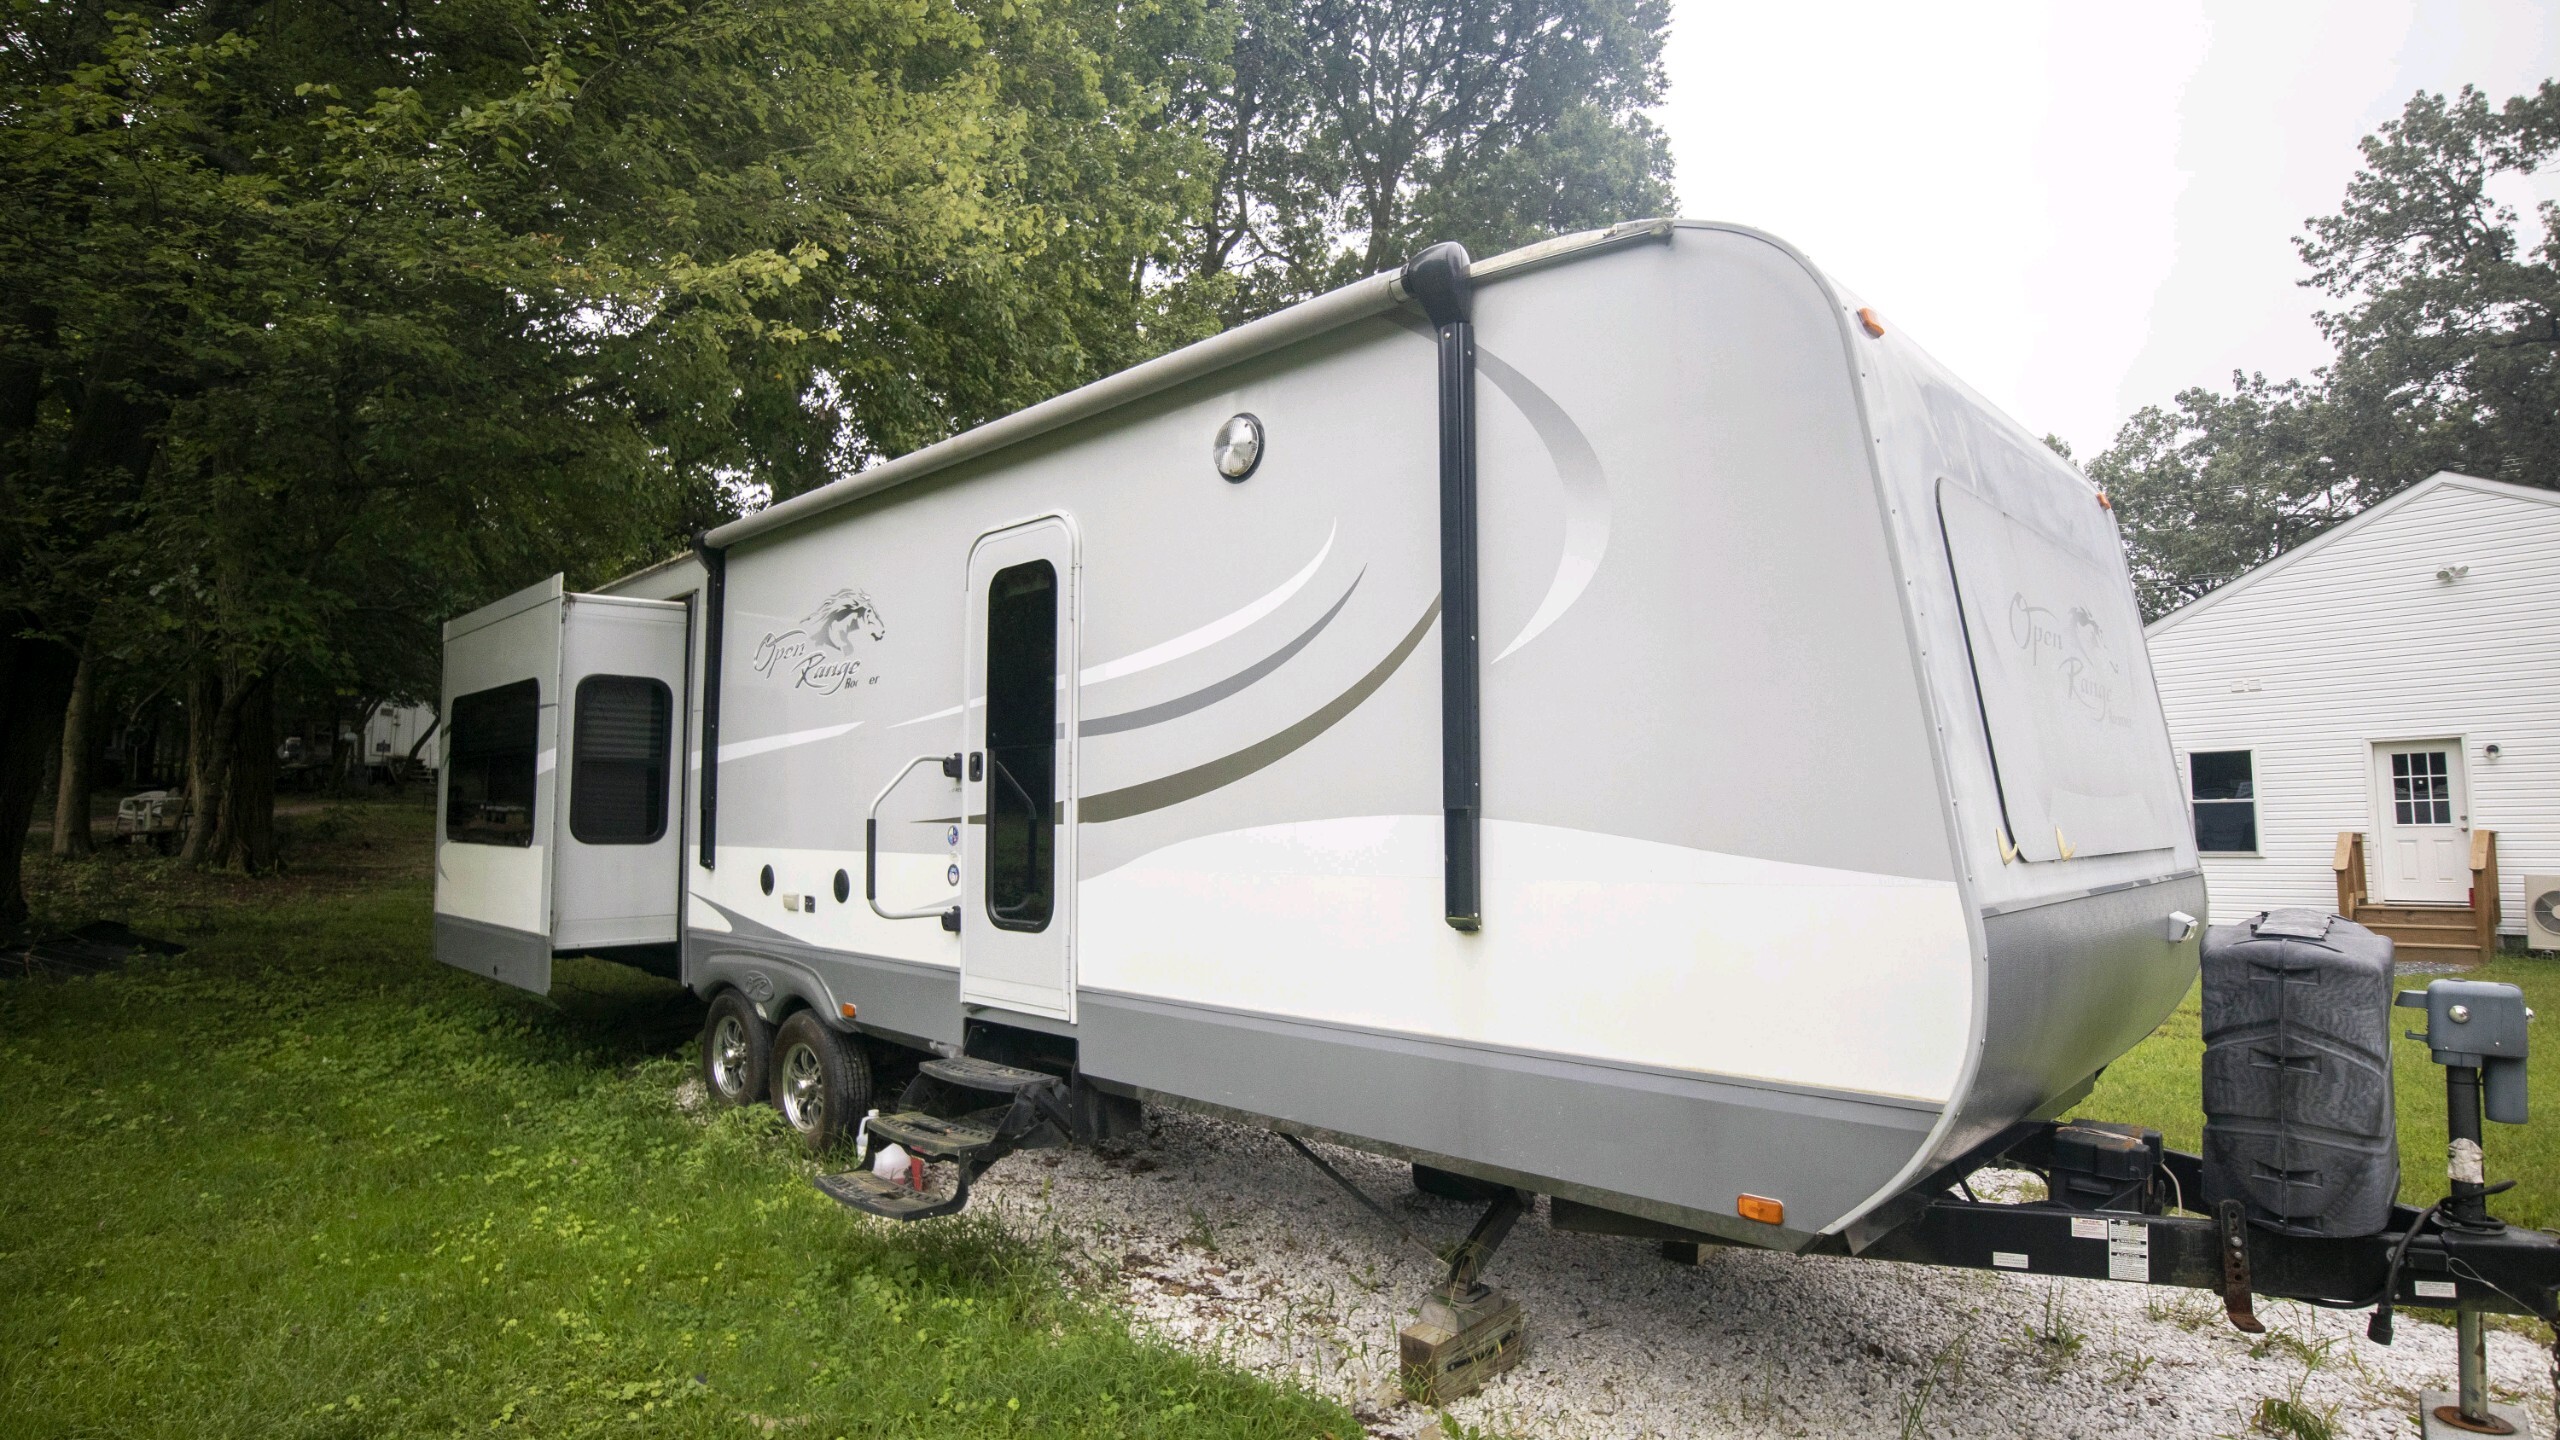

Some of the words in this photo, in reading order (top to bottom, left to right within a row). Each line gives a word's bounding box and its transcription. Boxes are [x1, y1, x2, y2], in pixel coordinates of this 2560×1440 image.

[753, 630, 806, 679] Open
[2009, 591, 2063, 666] Open
[791, 651, 860, 696] Range
[2058, 656, 2112, 722] Range
